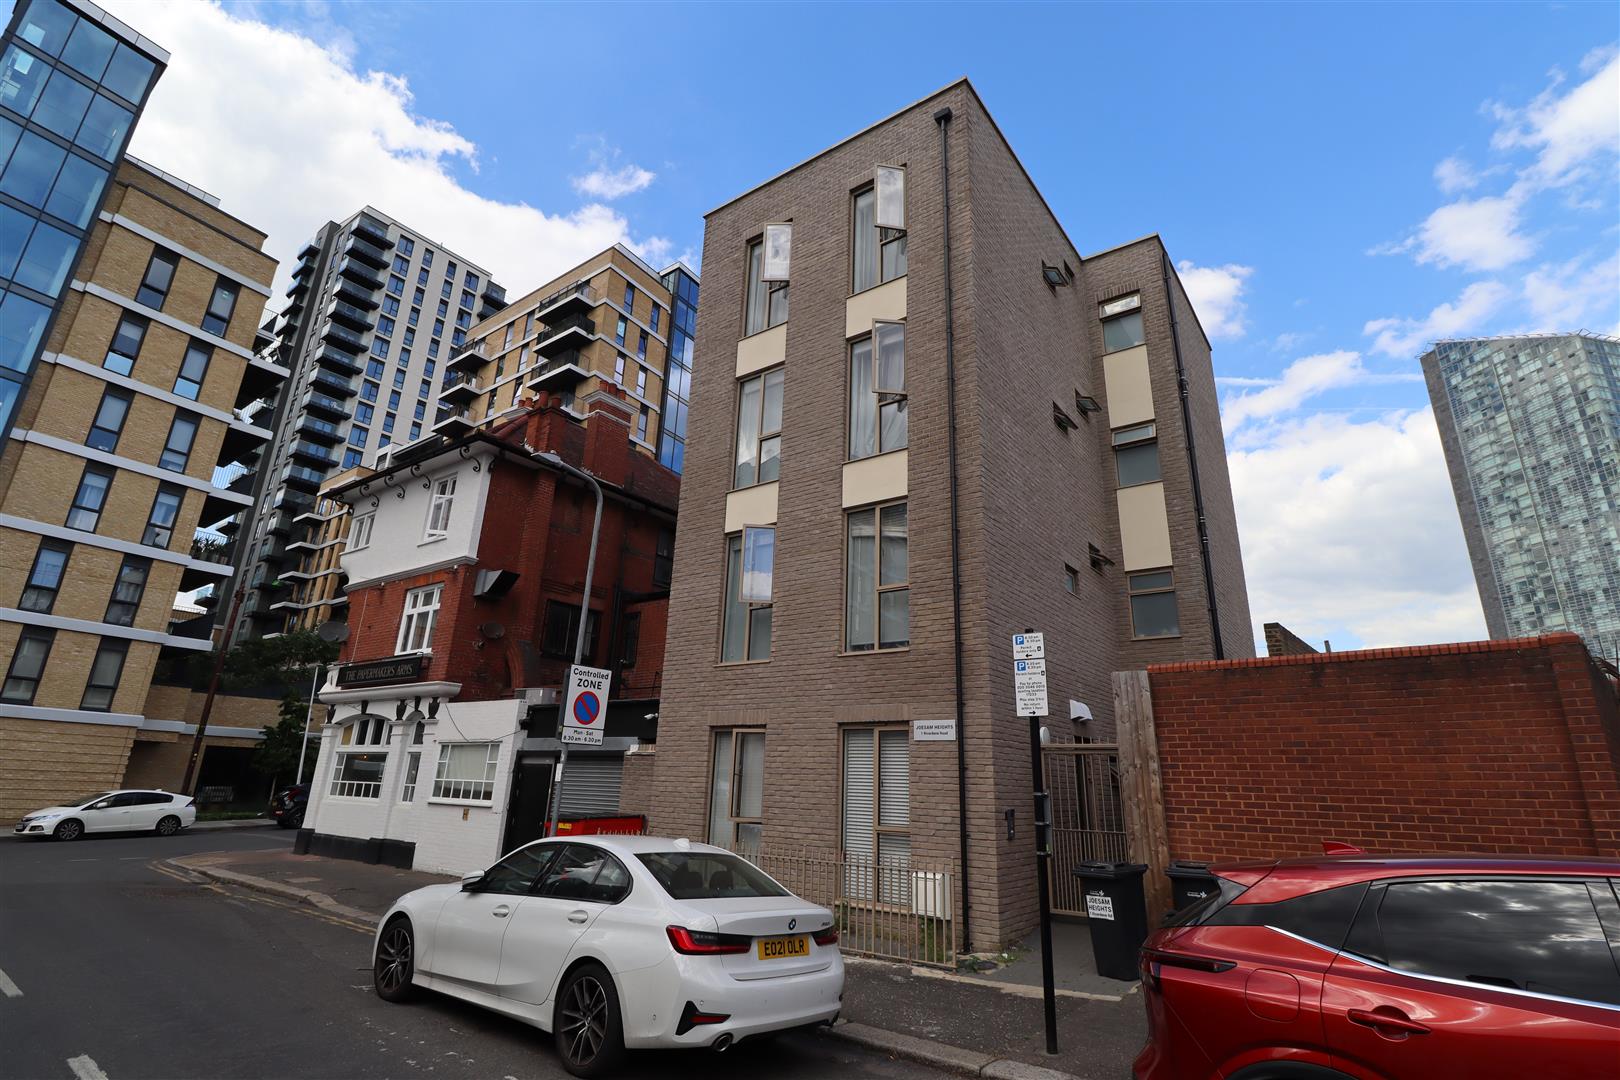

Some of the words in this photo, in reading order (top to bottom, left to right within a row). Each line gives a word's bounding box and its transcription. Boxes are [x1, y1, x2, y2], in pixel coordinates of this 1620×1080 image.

[346, 671, 357, 680] THE
[357, 666, 396, 680] PAPERMAKERS
[396, 664, 413, 675] ARMS
[574, 668, 609, 680] Controlled
[577, 679, 602, 690] ZONE
[764, 941, 785, 956] EO21
[787, 939, 805, 954] OLR
